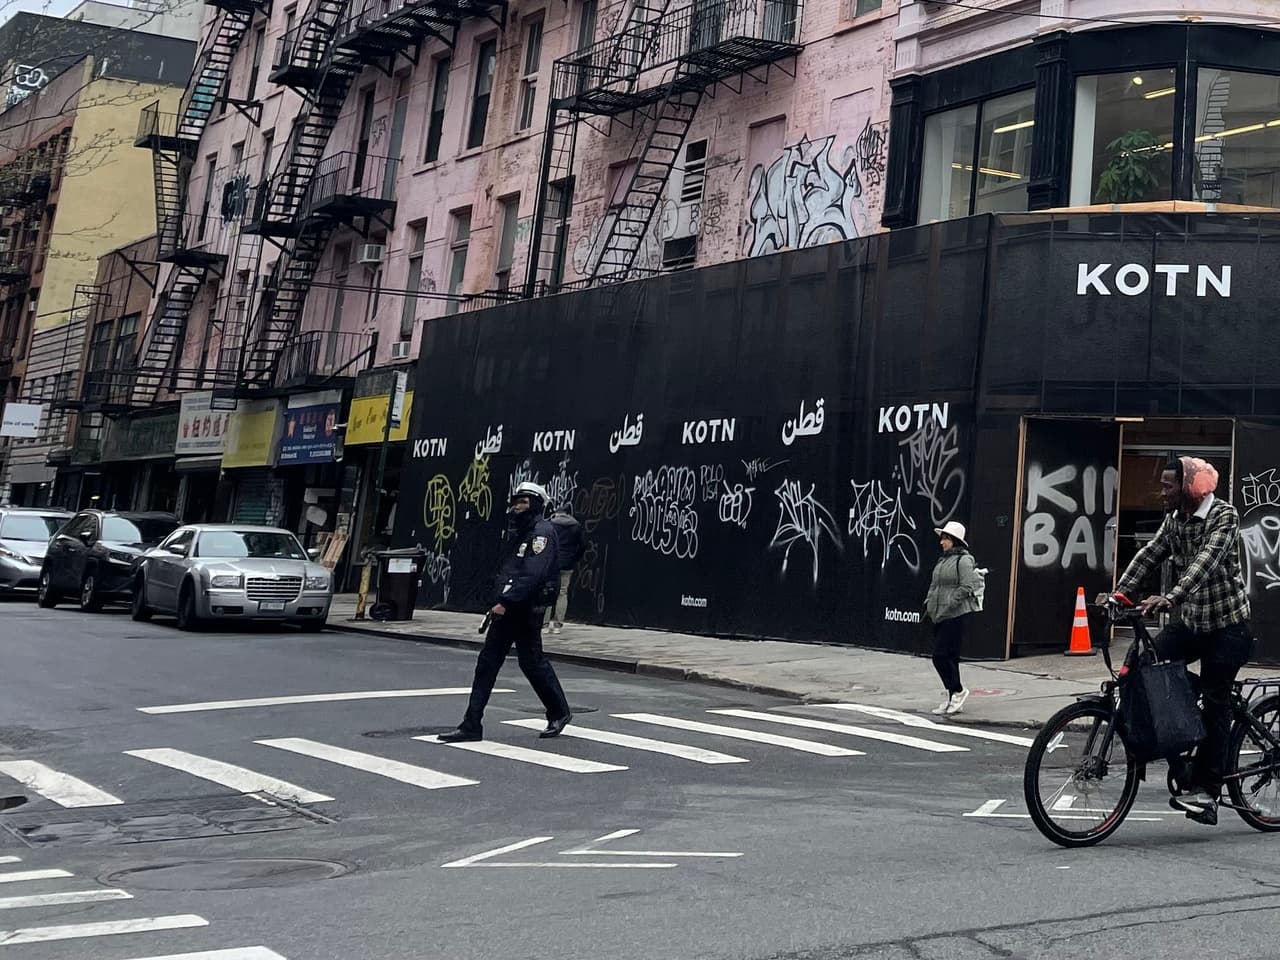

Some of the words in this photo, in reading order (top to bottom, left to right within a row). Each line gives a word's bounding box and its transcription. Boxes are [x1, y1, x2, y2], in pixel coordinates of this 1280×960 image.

[1077, 263, 1232, 297] KOTN
[682, 418, 736, 444] KOTN
[782, 397, 824, 445] قطن
[879, 402, 949, 433] KOTN
[475, 424, 503, 460] قطن
[532, 429, 576, 452] KOTN
[610, 412, 643, 453] قطن
[413, 438, 447, 458] KOTN
[681, 594, 707, 607] kotn.com
[885, 607, 920, 623] kotn.com
